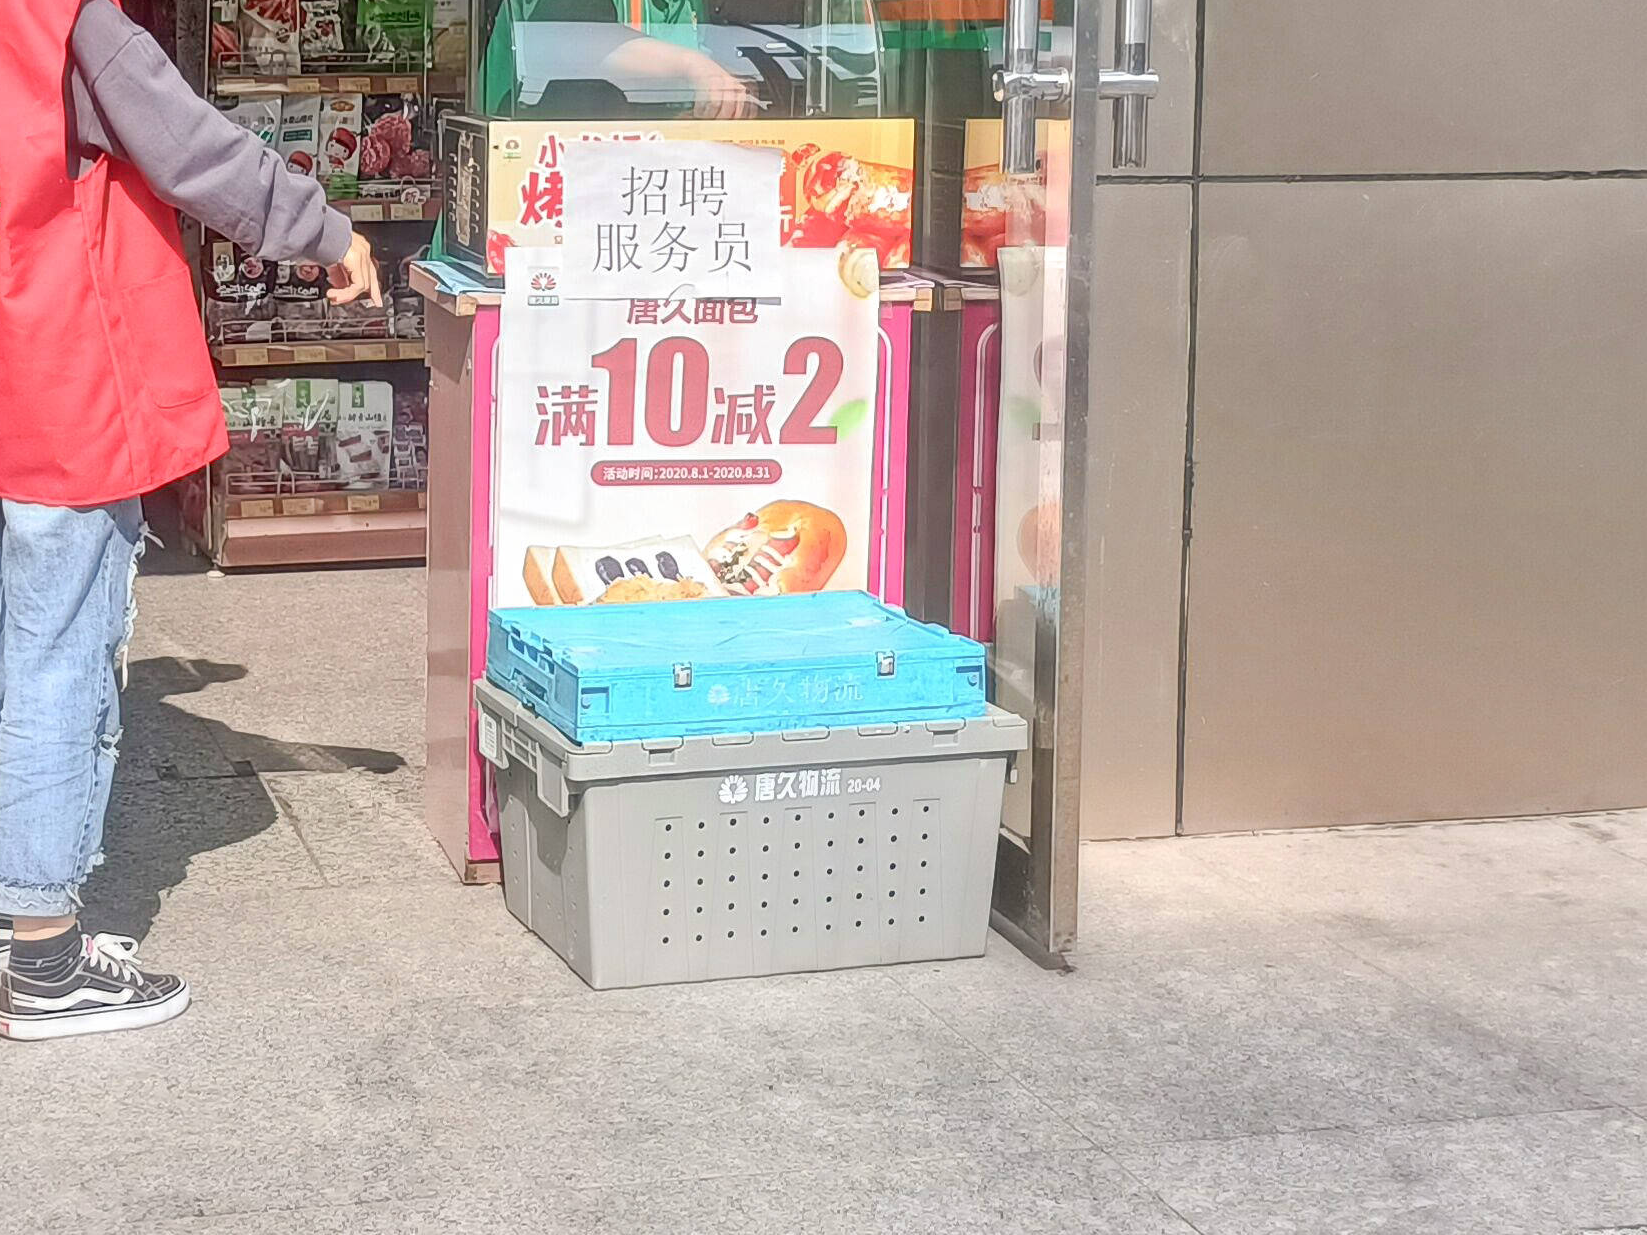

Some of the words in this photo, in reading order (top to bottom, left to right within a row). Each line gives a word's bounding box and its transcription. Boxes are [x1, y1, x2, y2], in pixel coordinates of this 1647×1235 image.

[621, 165, 728, 216] 招聘
[593, 220, 752, 274] 服务员
[626, 297, 759, 325] 唐久面包
[754, 769, 842, 802] 唐久物流
[847, 777, 882, 794] 20-04
